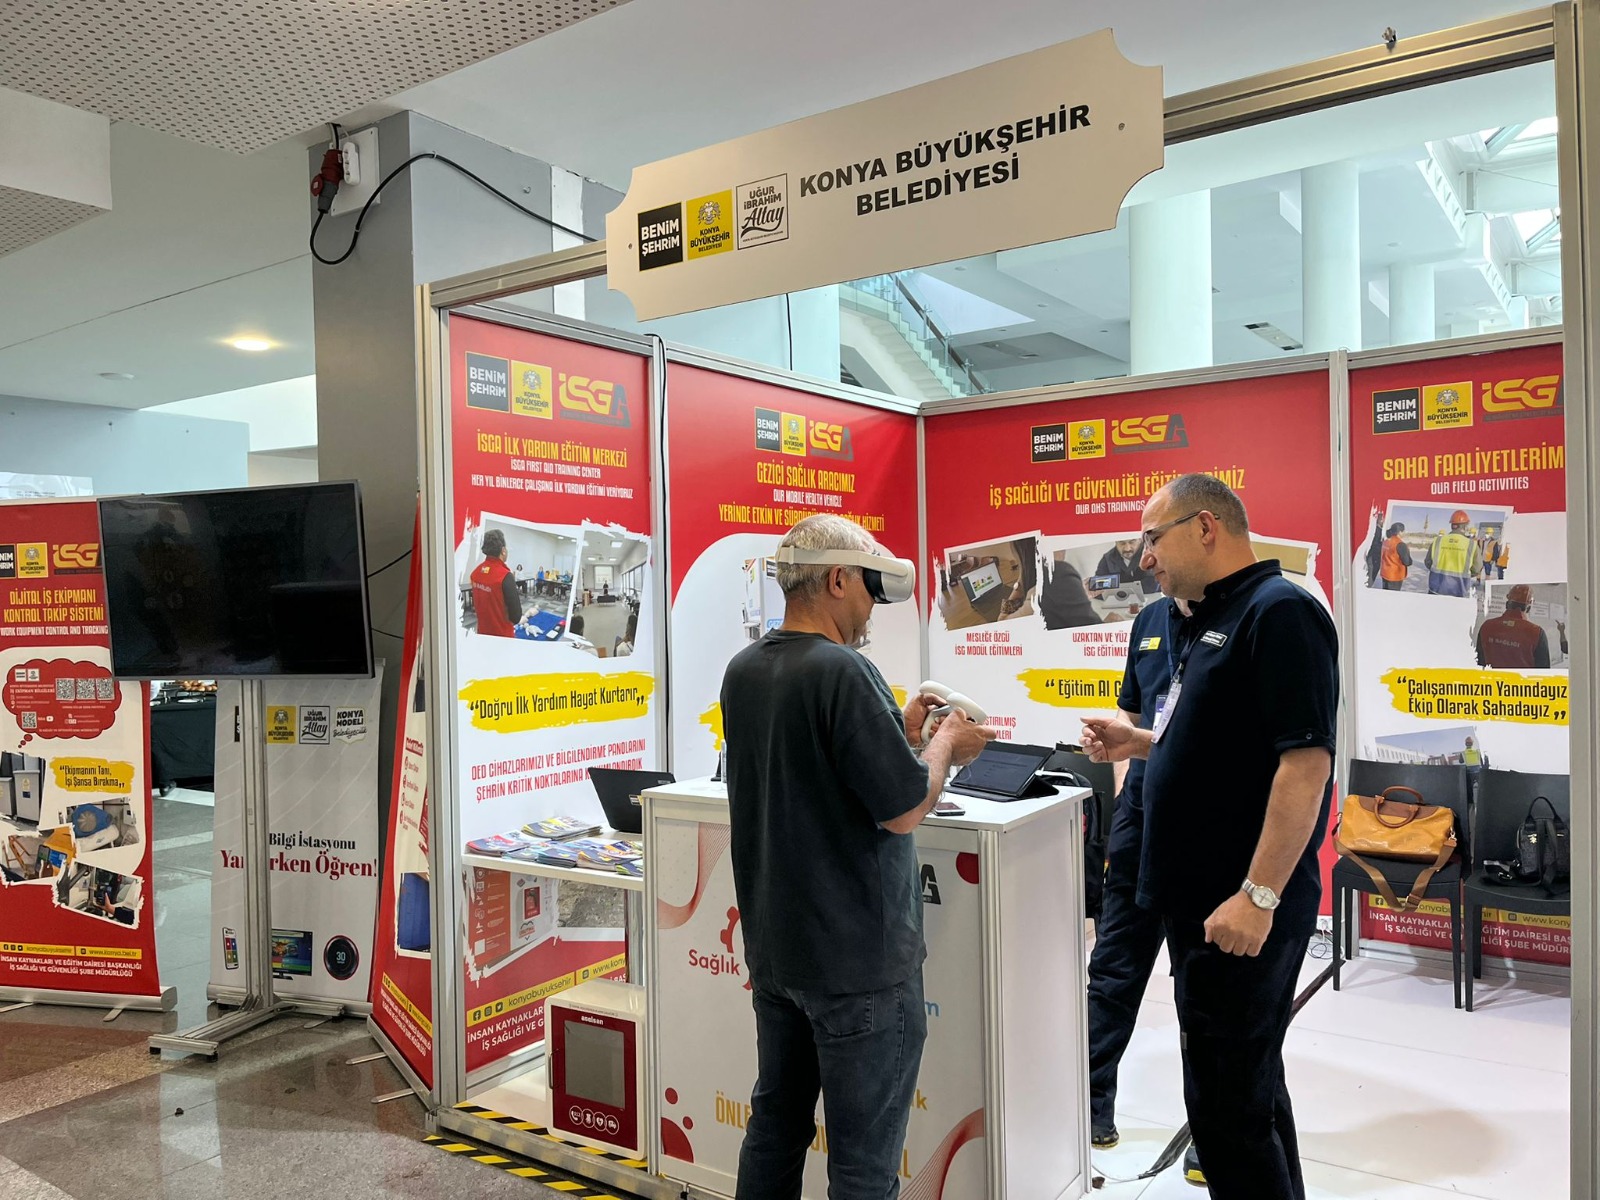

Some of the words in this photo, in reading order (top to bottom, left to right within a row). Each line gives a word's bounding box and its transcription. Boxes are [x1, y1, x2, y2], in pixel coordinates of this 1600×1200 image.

[799, 158, 888, 198] KONYA
[896, 103, 1092, 175] BÜYÜKŞEHİR
[749, 186, 775, 199] UĞUR
[856, 153, 1020, 216] BELEDİYESİ
[700, 226, 720, 236] KONYA
[741, 206, 785, 238] Altay
[690, 231, 730, 248] BÜYÜKŞEHİR
[477, 428, 502, 454] İSGA
[504, 432, 520, 456] İLK
[522, 438, 559, 460] YARDIM
[561, 439, 590, 464] EĞİTİM
[593, 447, 627, 468] MERKEZİ
[510, 456, 525, 471] İSGA
[526, 460, 543, 473] FIRST
[543, 462, 554, 474] AID
[555, 463, 580, 477] TRAINING
[582, 467, 601, 479] CENTER
[1384, 456, 1429, 481] SAHA
[1435, 441, 1564, 478] FAALİYETLERİM
[471, 474, 484, 486] HER
[485, 475, 495, 487] YIL
[495, 474, 524, 490] BİNLERCE
[525, 478, 553, 493] ÇALIŞANA
[554, 479, 563, 493] İLK
[564, 482, 585, 495] YARDIM
[586, 482, 606, 496] EĞİTİMİ
[606, 485, 633, 499] VERİYORUZ
[757, 459, 784, 485] GEZİCİ
[787, 462, 816, 489] SAĞLIK
[818, 469, 855, 493] ARACIMIZ
[1431, 481, 1450, 495] OUR
[1452, 480, 1476, 494] FIELD
[1479, 476, 1529, 492] ACTIVITIES
[773, 489, 785, 502] OUR
[785, 490, 805, 505] MOBILE
[805, 492, 823, 506] HEALTH
[823, 494, 842, 508] VEHICLE
[990, 484, 1002, 510] İŞ
[1005, 479, 1052, 506] SAĞLIĞI
[1056, 483, 1070, 502] VE
[1074, 472, 1140, 501] GÜVENLİĞİ
[719, 501, 750, 523] YERİNDE
[752, 504, 773, 525] ETKİN
[774, 508, 783, 525] VE
[1075, 504, 1090, 516] OUR
[1091, 502, 1106, 514] OHS
[1107, 500, 1146, 513] TRAININGS
[10, 587, 41, 605] DİJİTAL
[43, 587, 52, 607] İŞ
[54, 586, 96, 603] EKİPMANI
[4, 608, 41, 623] KONTROL
[43, 604, 68, 622] TAKİP
[69, 603, 104, 621] SİSTEMİ
[45, 626, 69, 636] CONTROL
[69, 626, 81, 635] AND
[81, 625, 108, 635] TRACKING
[966, 630, 992, 643] MESLEĞE
[993, 630, 1010, 642] ÖZGÜ
[1072, 632, 1103, 642] UZAKTAN
[1104, 632, 1113, 642] VE
[1115, 630, 1128, 642] YÜZ
[955, 643, 966, 656] İSG
[967, 644, 988, 656] MODÜL
[989, 643, 1023, 656] EĞİTİMLERİ
[1083, 644, 1096, 657] İSG
[1097, 644, 1128, 657] EĞİTİMLE
[1059, 678, 1094, 699] Eğitim
[1098, 680, 1110, 697] Al
[1496, 681, 1567, 700] Yanındayız
[516, 692, 529, 715] İlk
[532, 693, 568, 713] Yardım
[570, 689, 598, 710] Hayat
[1408, 698, 1433, 716] Ekip
[1437, 698, 1478, 715] Olarak
[337, 710, 364, 719] KONYA
[471, 763, 487, 780] OED
[488, 755, 544, 778] CİHAZLARIMIZI
[546, 754, 555, 767] VE
[556, 744, 607, 766] BİLGİLENDİRME
[608, 738, 646, 756] PANOLARINI
[476, 780, 505, 804] ŞEHRİN
[507, 776, 533, 796] KRİTİK
[534, 769, 584, 790] NOKTALARINA
[269, 832, 296, 850] Bilgi
[299, 830, 356, 852] İstasyonu
[315, 850, 377, 881] Öğren!
[1369, 910, 1397, 921] İNSAN
[1400, 916, 1452, 929] KAYNAKLA
[1481, 925, 1510, 937] ĞİTİM
[1512, 930, 1551, 942] DAİRESİ
[1385, 923, 1394, 934] İŞ
[1395, 925, 1432, 937] SAĞLIĞI
[1505, 939, 1530, 949] ŞUBE
[1532, 942, 1569, 953] MÜDÜR
[16, 963, 38, 972] SAĞLIĞI
[47, 965, 78, 974] GÜVENLİĞİ
[79, 968, 94, 976] ŞUBE
[95, 969, 133, 977] MÜDÜRLÜĞÜ
[18, 957, 54, 965] KAYNAKLARI
[63, 957, 82, 966] EĞİTİM
[83, 960, 106, 968] DAİRESİ
[107, 961, 142, 970] BAŞKANLIĞI
[688, 948, 741, 977] Sağlık
[508, 977, 572, 1008] konyabuyuksehir
[467, 1026, 494, 1044] İNSAN
[496, 1006, 544, 1032] KAYNAKLAR
[482, 1039, 490, 1052] İŞ
[491, 1024, 524, 1047] SAĞLIĞI
[526, 1022, 536, 1032] VE
[715, 1090, 751, 1130] ÖNLE
